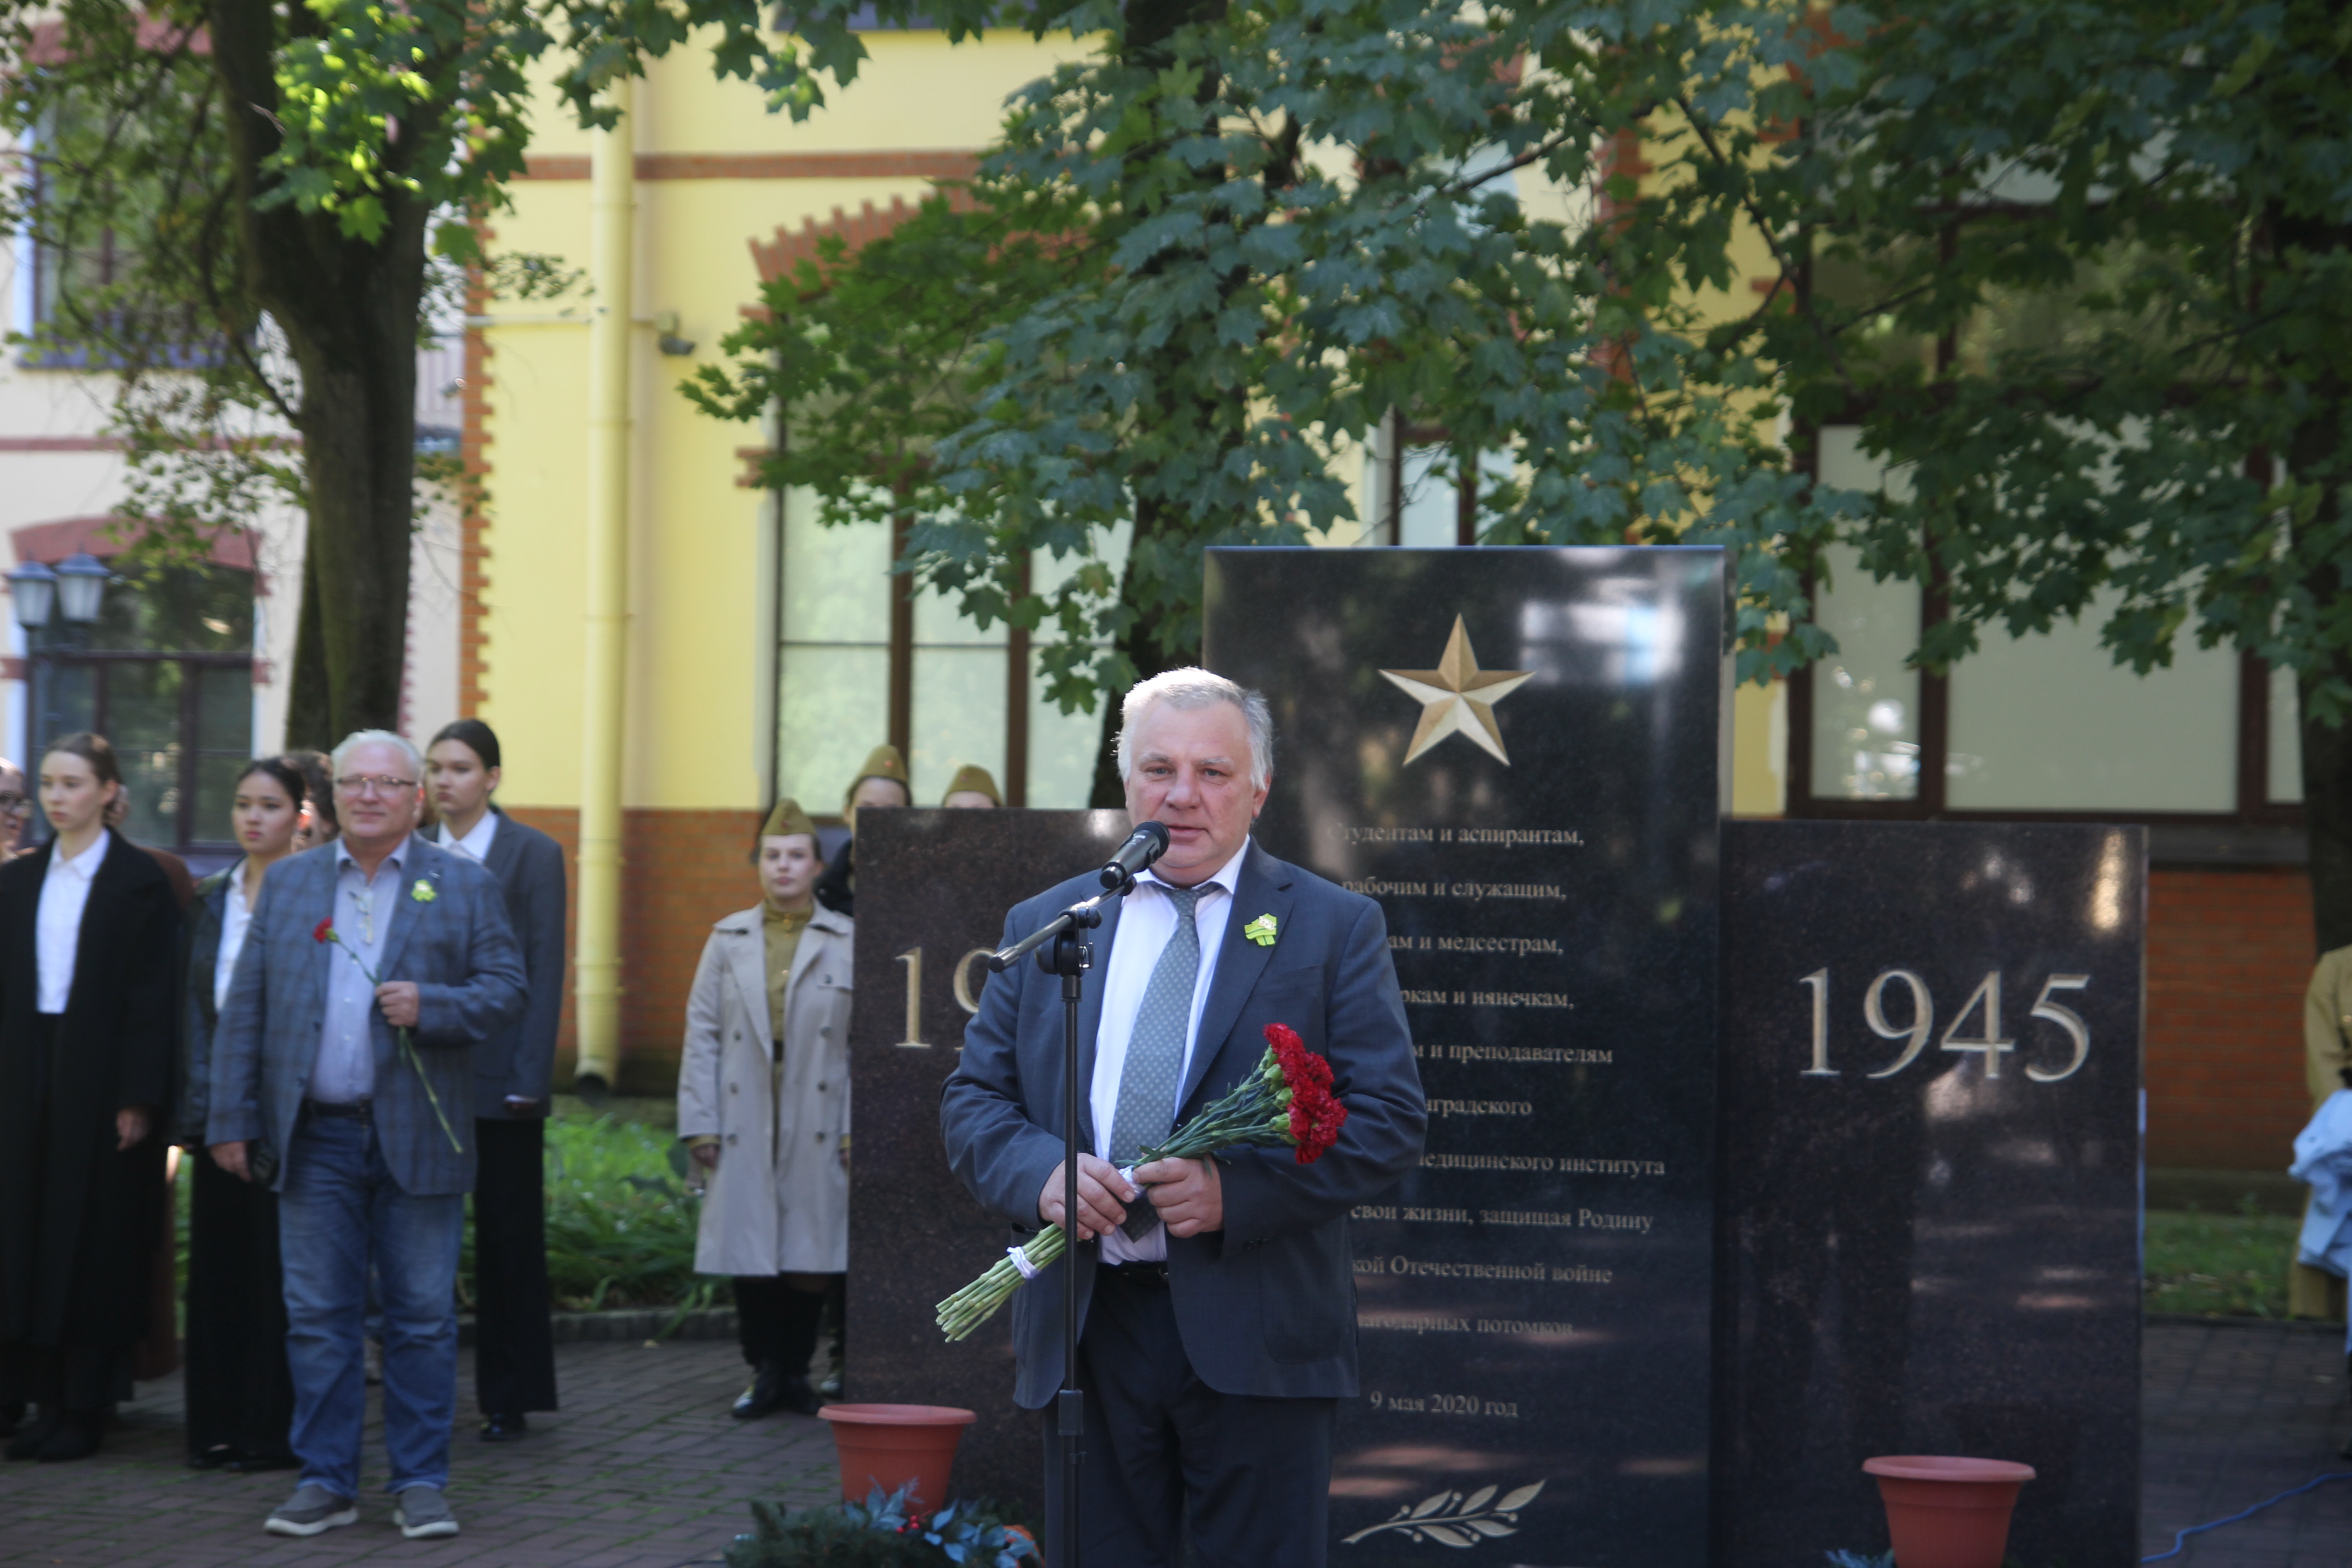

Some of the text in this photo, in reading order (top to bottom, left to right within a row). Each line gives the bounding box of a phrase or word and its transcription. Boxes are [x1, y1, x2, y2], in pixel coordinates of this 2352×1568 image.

[1440, 828, 1452, 842] и
[1458, 828, 1585, 849] аспирантам,
[1342, 876, 1567, 902] рабочим и служащим,
[1419, 936, 1432, 950] и
[1438, 937, 1563, 957] медсестрам,
[1453, 991, 1465, 1005] и
[1472, 991, 1574, 1010] нянечкам,
[1798, 966, 2091, 1083] 1945
[1430, 1044, 1443, 1058] и
[1449, 1045, 1612, 1064] преподавателям
[1426, 1098, 1533, 1119] нградского
[1559, 1157, 1666, 1180] института
[1350, 1205, 1654, 1235] свои жизни, защищая Родину
[1390, 1255, 1546, 1281] Отечественной
[1552, 1264, 1613, 1284] войне
[1370, 1391, 1519, 1419] 9 мая 2020 год
